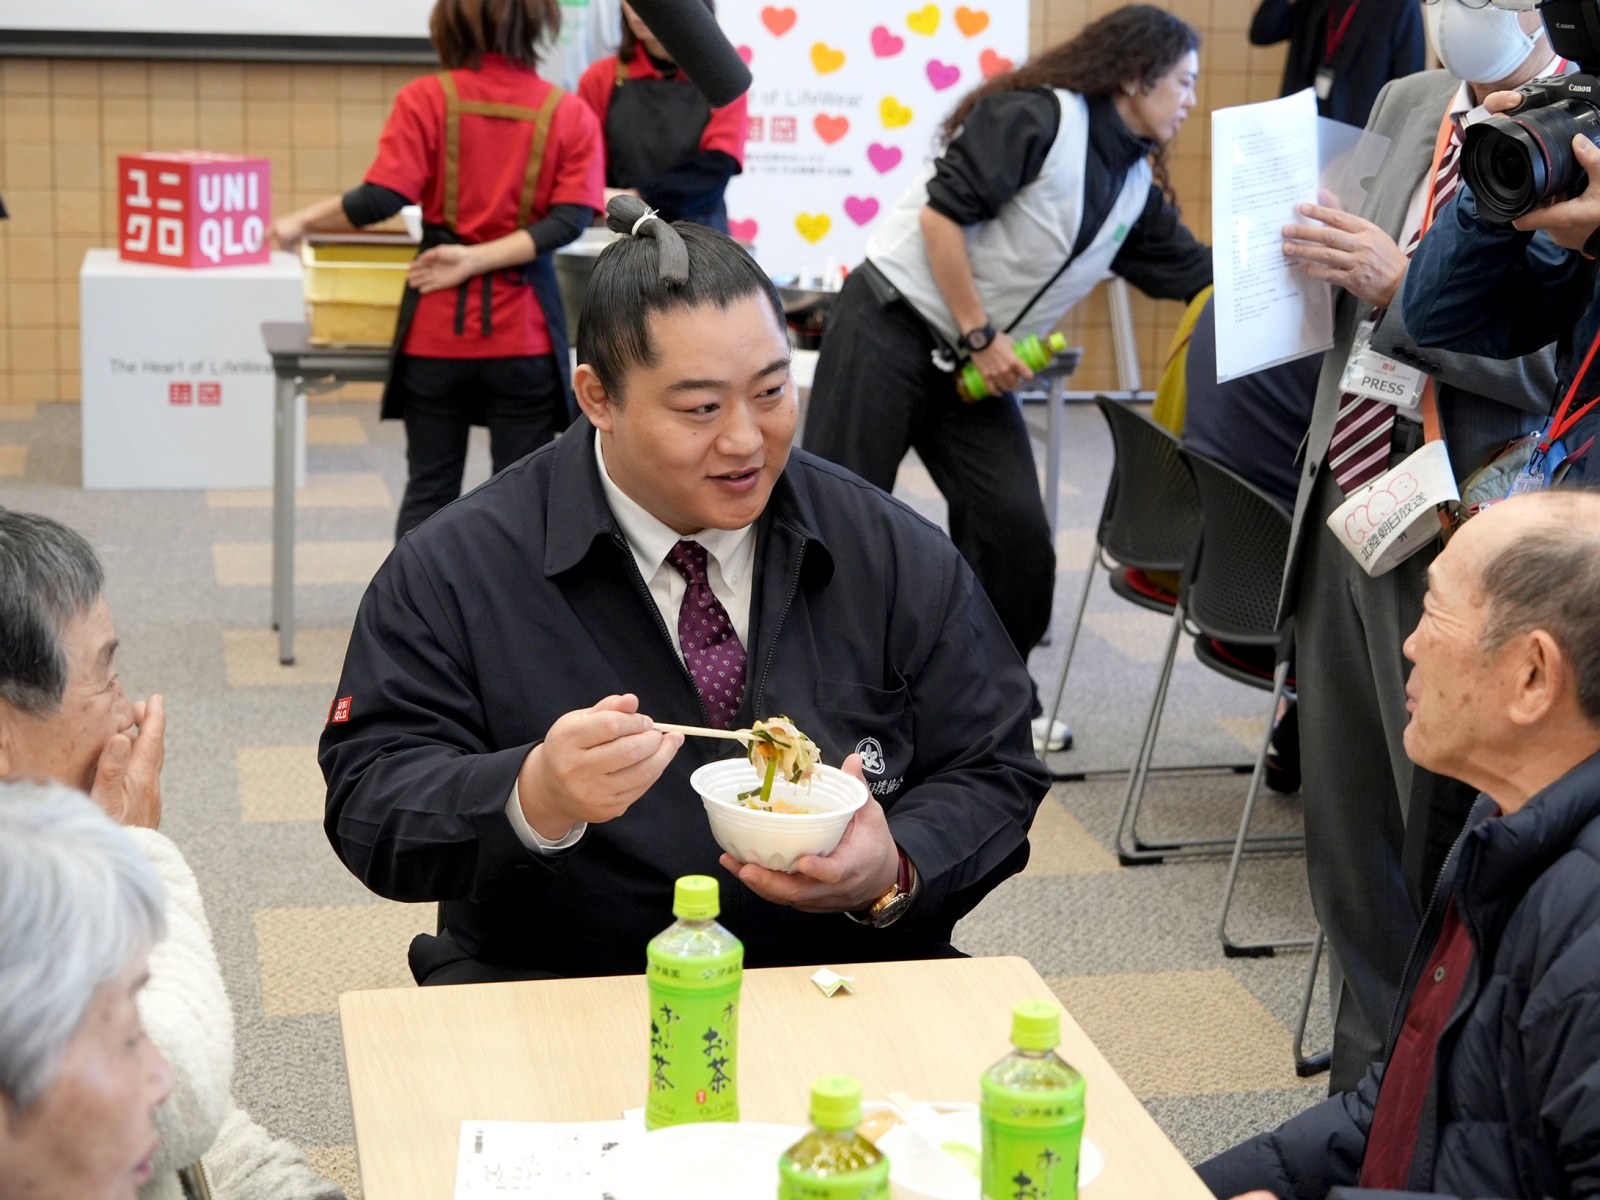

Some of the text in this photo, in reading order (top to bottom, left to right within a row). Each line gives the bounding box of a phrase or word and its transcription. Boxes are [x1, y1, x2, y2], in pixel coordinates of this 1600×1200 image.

[1555, 22, 1576, 30] Canon
[1568, 83, 1592, 93] Canon
[126, 169, 183, 212] ユニ
[199, 171, 258, 213] UNI
[124, 213, 184, 256] クロ
[199, 215, 264, 263] QLO
[110, 359, 137, 373] The
[141, 359, 185, 374] Heart
[1361, 376, 1405, 396] PRESS
[1360, 492, 1428, 562] 北陸朝日放送
[334, 709, 347, 721] QLO
[337, 700, 349, 710] UNI
